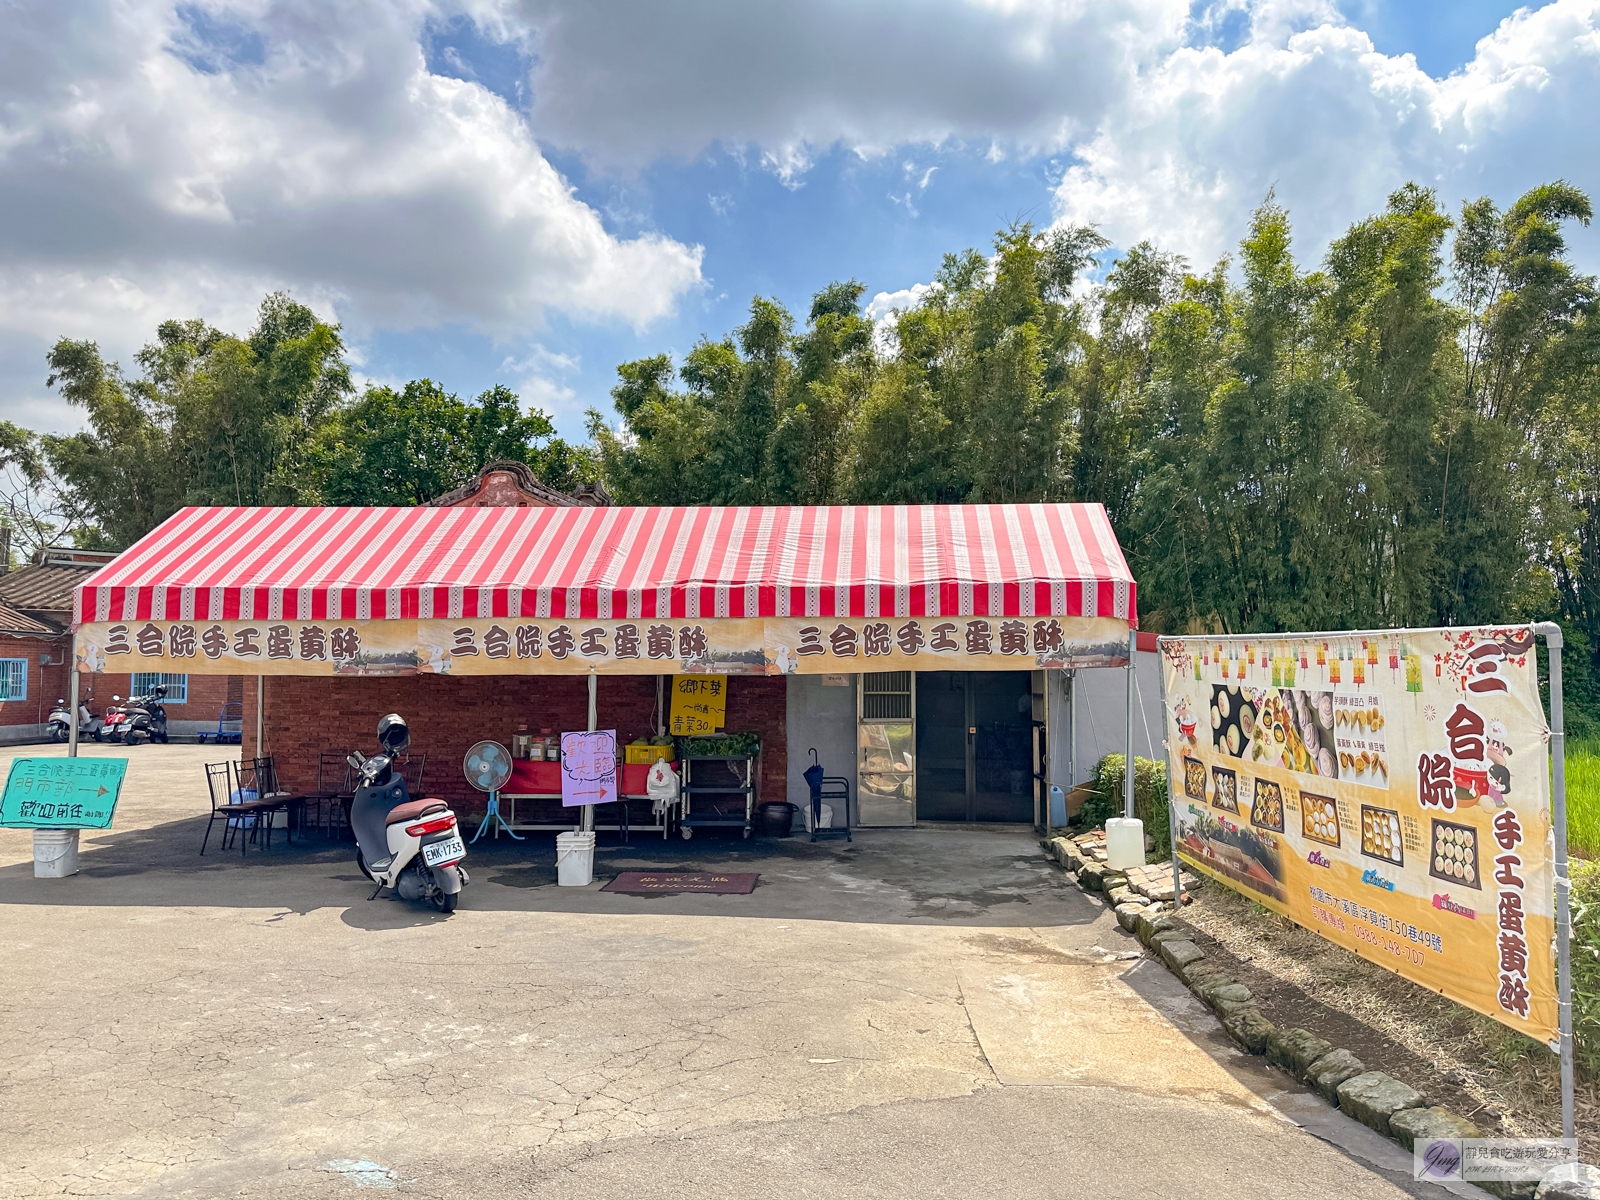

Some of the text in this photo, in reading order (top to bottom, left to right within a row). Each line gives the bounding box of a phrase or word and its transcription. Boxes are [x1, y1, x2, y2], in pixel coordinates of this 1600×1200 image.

[104, 622, 360, 660] 三合院手工蛋黃酥
[449, 624, 708, 659] 三合院手工蛋黃酥
[796, 619, 1064, 655] 三合院手工蛋黃酥
[13, 777, 75, 797] 門市部
[24, 763, 125, 778] 三合院手工蛋黃酥
[425, 842, 463, 861] EMK-1733
[1494, 810, 1530, 1017] 手工蛋黃酥
